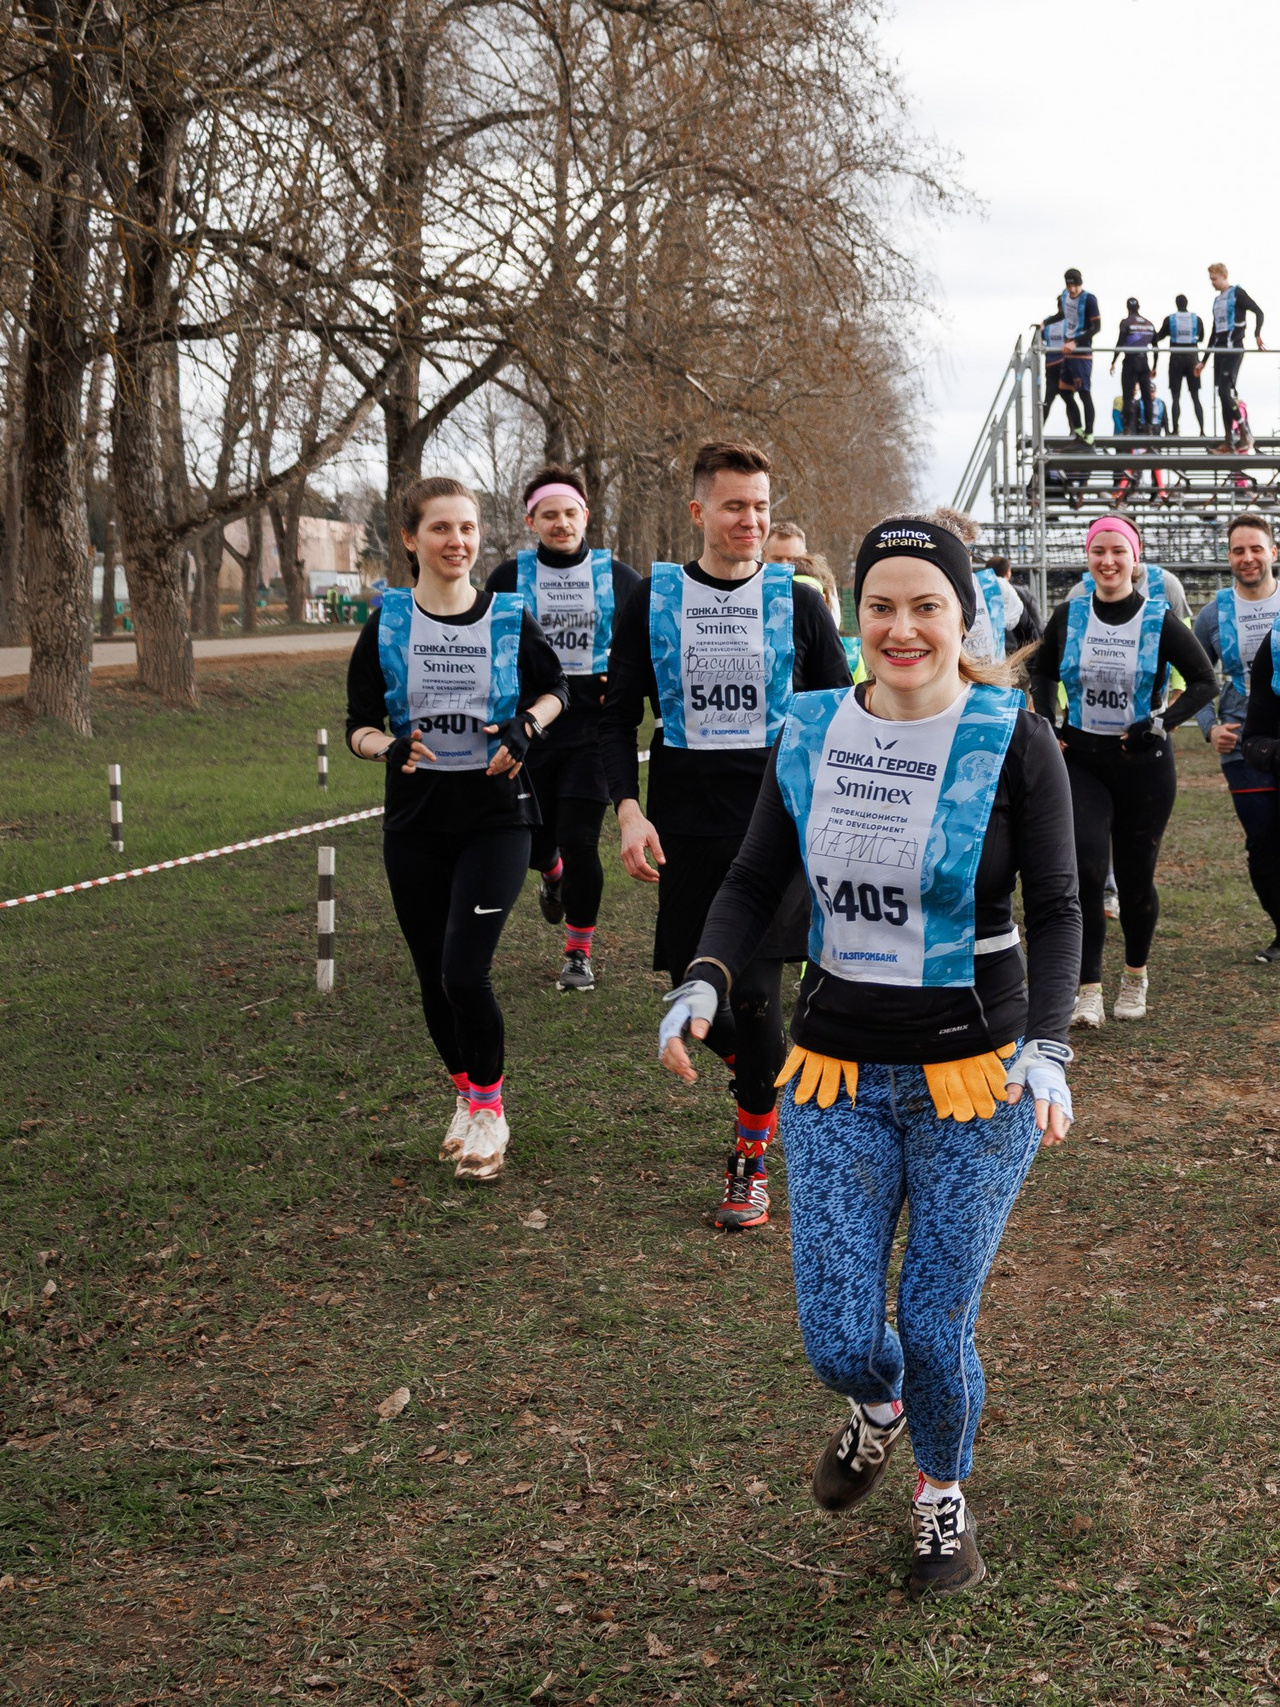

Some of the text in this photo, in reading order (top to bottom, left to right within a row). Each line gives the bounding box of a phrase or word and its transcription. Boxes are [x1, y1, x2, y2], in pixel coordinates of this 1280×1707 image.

[880, 529, 931, 541] Sminex
[887, 538, 923, 548] team
[547, 592, 583, 600] Sminex
[686, 606, 758, 616] ГОНКА ГЕРОЕВ
[696, 622, 748, 635] Sminex
[545, 631, 589, 650] 5404
[1087, 636, 1136, 645] ГОНКА ГЕРОЕВ
[414, 644, 487, 654] ГОНКА ГЕРОЕВ
[1092, 646, 1127, 659] Sminex
[423, 659, 476, 674] Sminex
[690, 684, 758, 711] 5409
[1085, 688, 1128, 710] 5403
[418, 714, 480, 735] 5401
[828, 749, 938, 776] ГОНКА ГЕРОЕВ
[834, 775, 913, 805] Sminex
[831, 806, 908, 823] ПЕРФЕКЦИОНИСТЫ
[828, 817, 905, 833] FINE DEVELOPMENT
[816, 875, 909, 926] 5405
[839, 951, 898, 962] ГАЗПРОМБАНК
[939, 1024, 969, 1034] DEMIX
